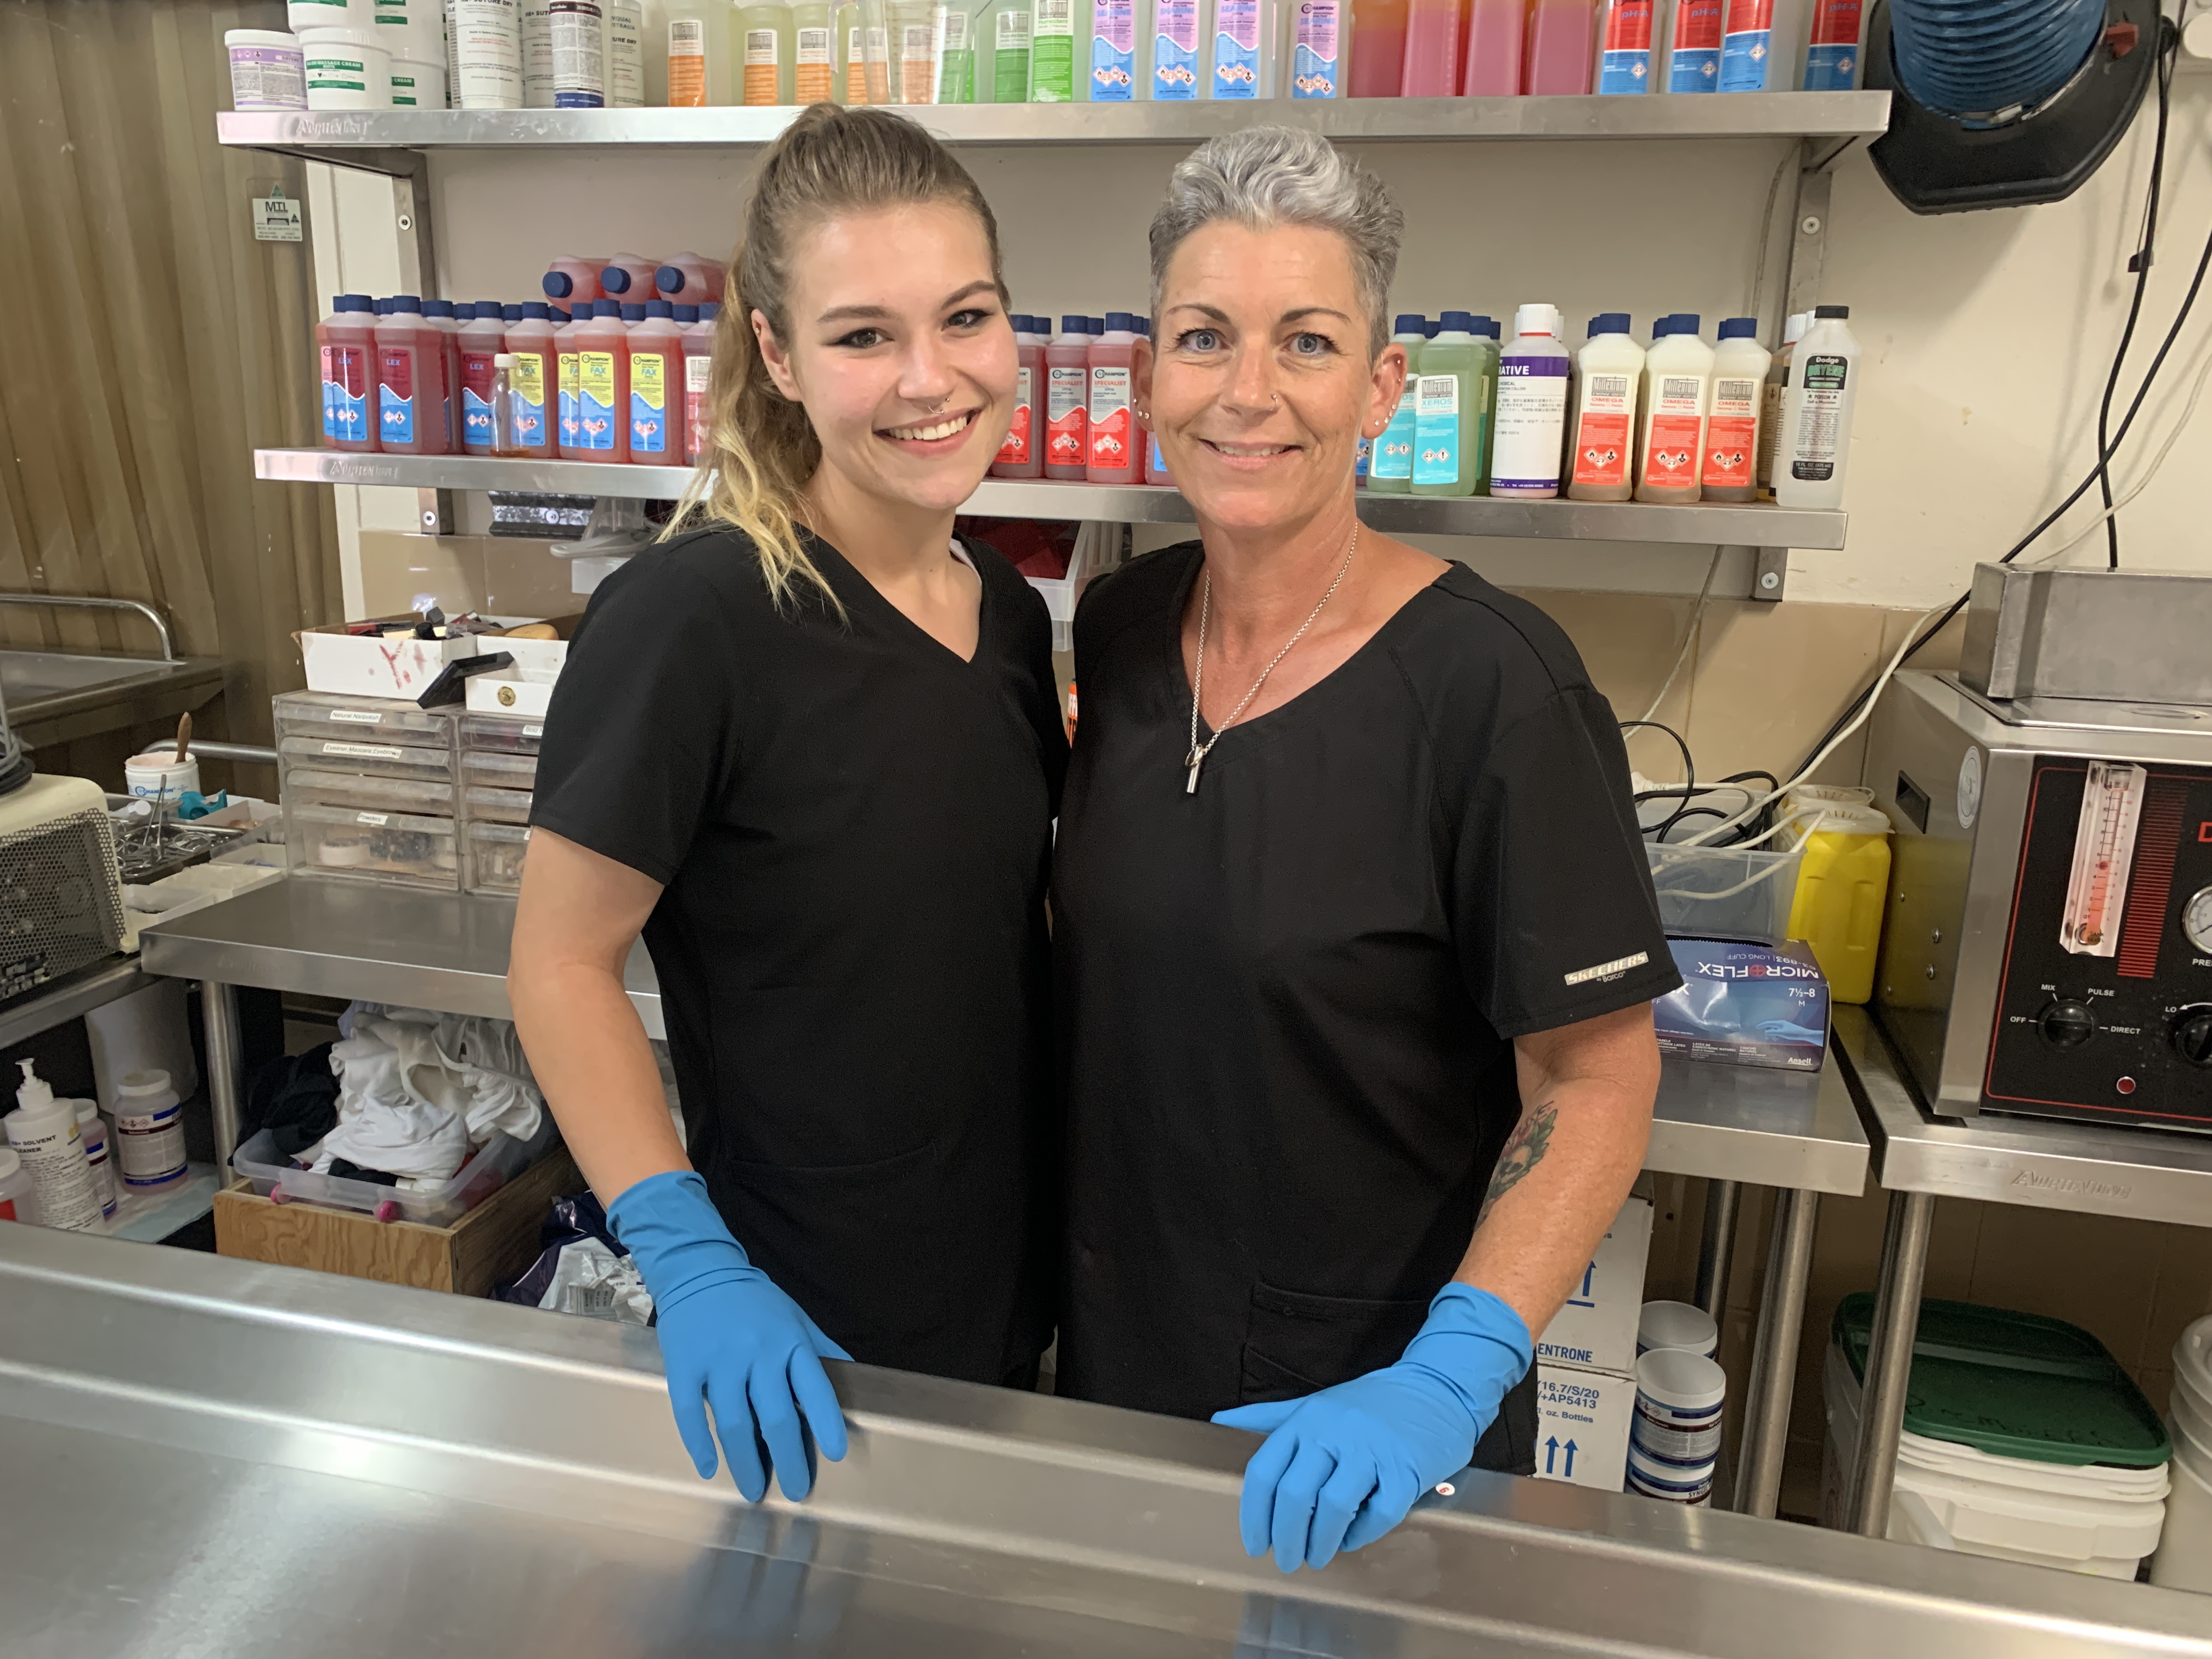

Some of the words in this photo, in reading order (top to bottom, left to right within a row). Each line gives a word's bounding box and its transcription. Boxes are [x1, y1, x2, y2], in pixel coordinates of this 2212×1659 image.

[1423, 380, 1452, 393] Millenium
[1593, 378, 1626, 392] Millenium
[1664, 380, 1697, 393] Millenium
[1719, 382, 1752, 394] Millenium
[1568, 953, 1645, 984] SKECHERS
[1602, 972, 1624, 983] Barco
[2087, 988, 2114, 997] PULSE
[2111, 1026, 2141, 1035] DIRECT
[23, 1135, 56, 1146] SOLVENT
[1562, 1412, 1593, 1423] Bottles
